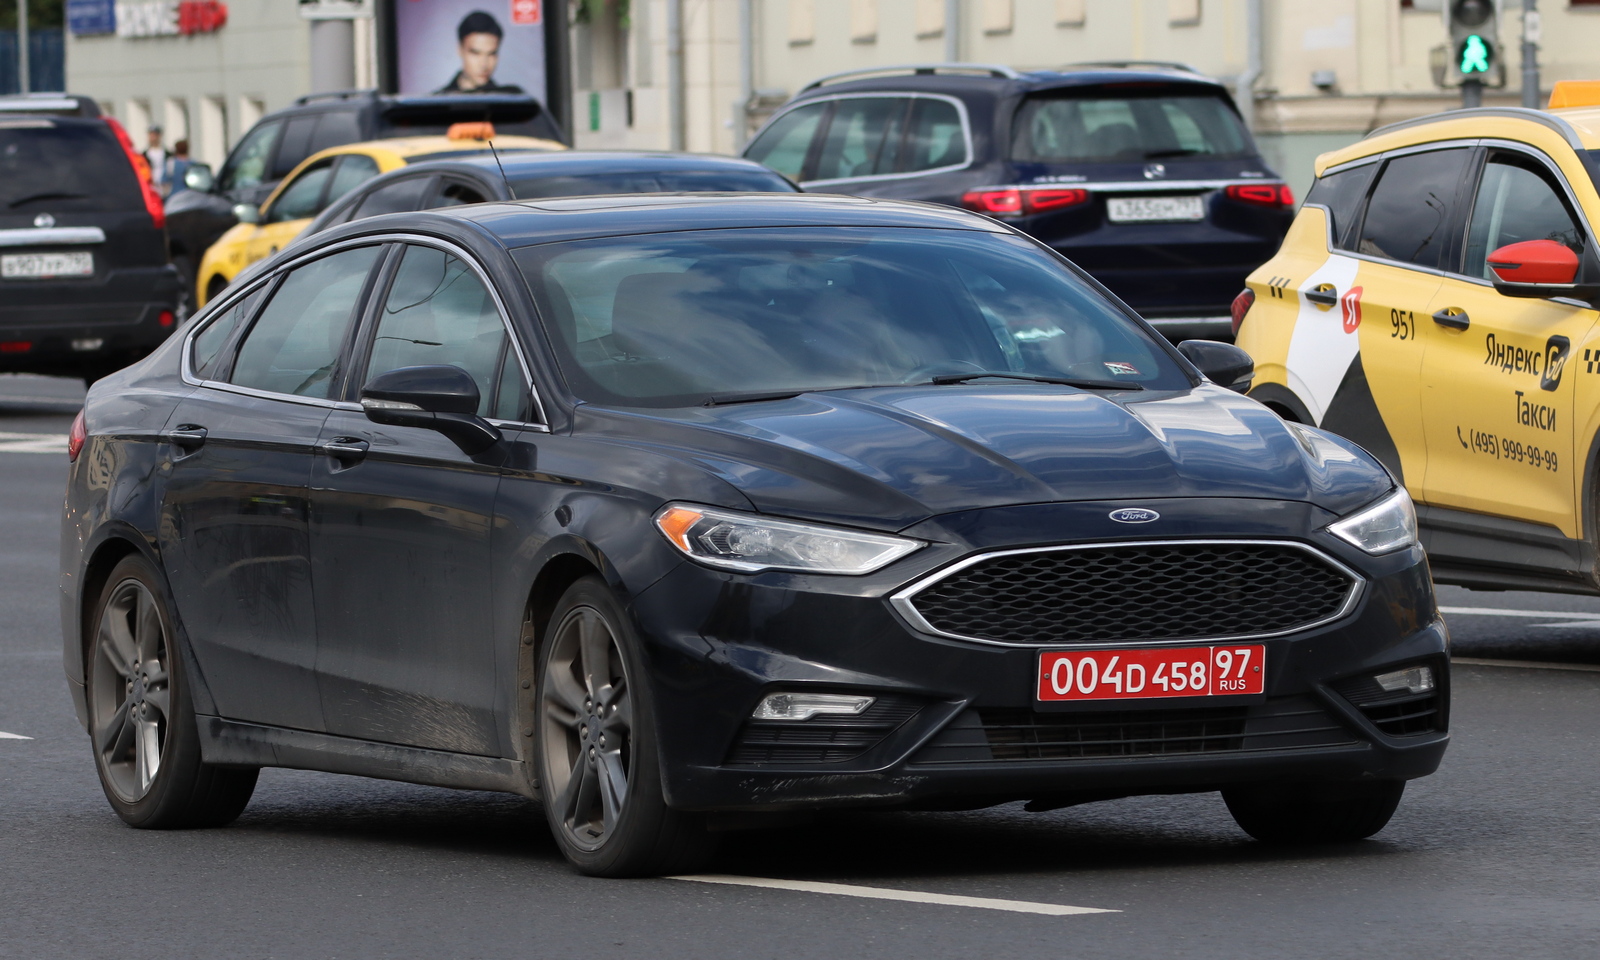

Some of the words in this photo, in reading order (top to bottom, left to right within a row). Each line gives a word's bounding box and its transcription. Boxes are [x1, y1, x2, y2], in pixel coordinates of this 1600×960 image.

[1390, 308, 1415, 341] 951
[1484, 332, 1542, 376] Яндекс
[1514, 390, 1556, 433] Такси
[1470, 428, 1500, 460] (495)
[1502, 438, 1558, 473] 999-99-99
[1121, 511, 1149, 520] Ford
[1215, 649, 1251, 679] 97
[1219, 679, 1247, 691] RUS
